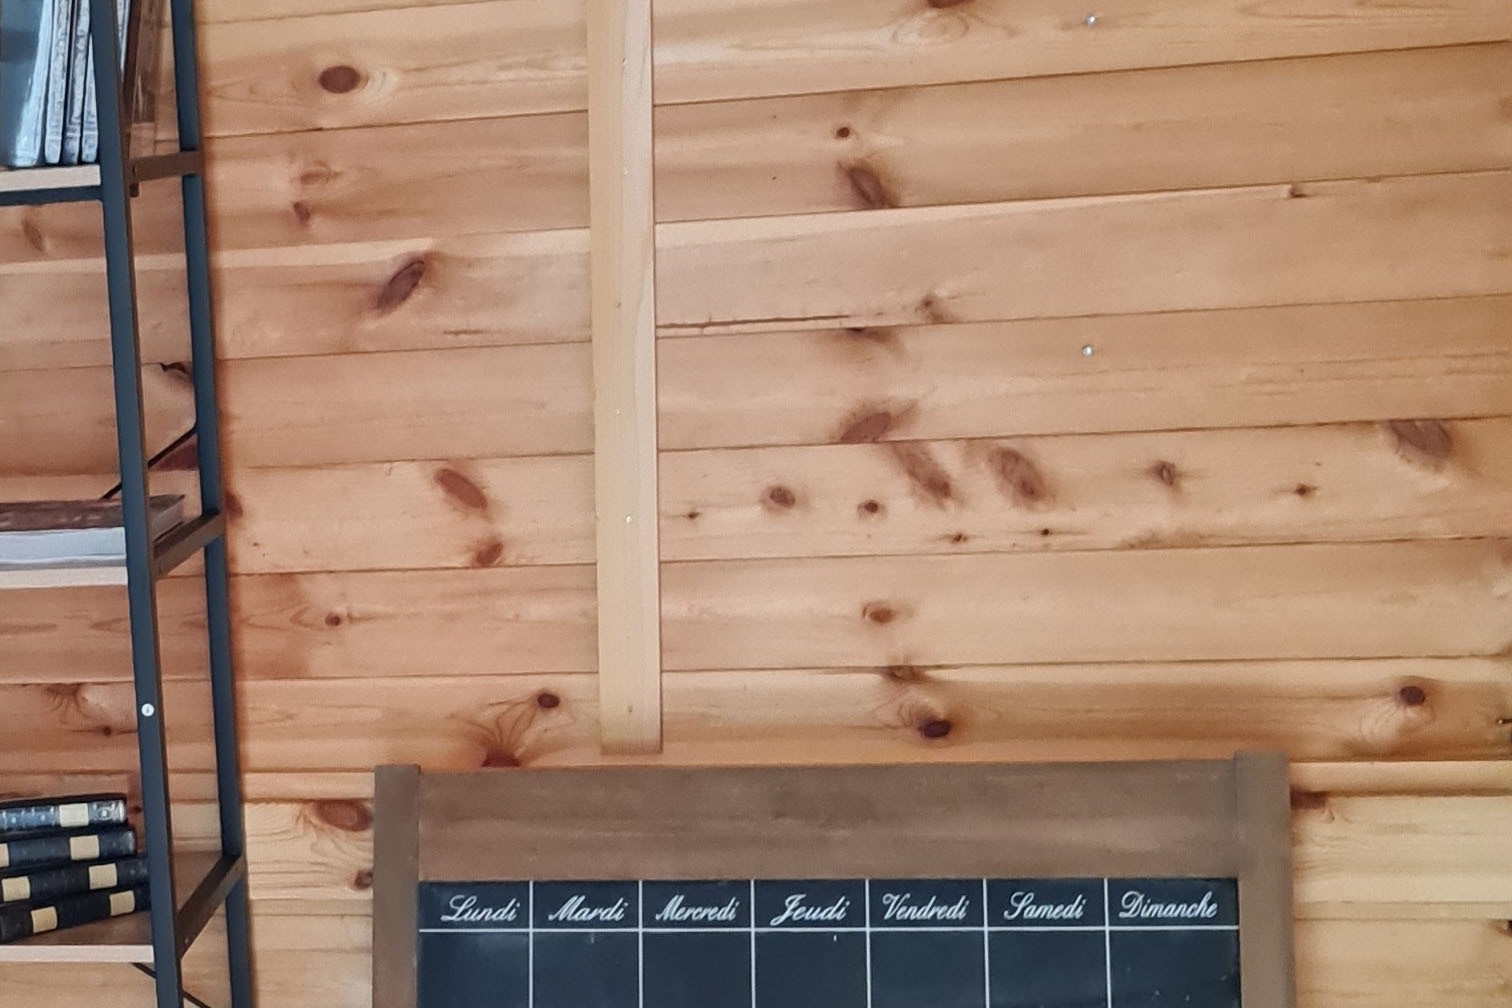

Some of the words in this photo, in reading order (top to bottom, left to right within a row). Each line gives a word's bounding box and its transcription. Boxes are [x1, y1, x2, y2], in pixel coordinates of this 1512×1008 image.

[440, 893, 521, 923] Lundi
[548, 894, 629, 922] Mardi
[655, 894, 740, 922] Mercredi
[770, 893, 851, 926] Jeudi
[882, 892, 971, 921] Vendredi
[1003, 890, 1087, 921] Samedi
[1119, 890, 1219, 920] Dimanche
